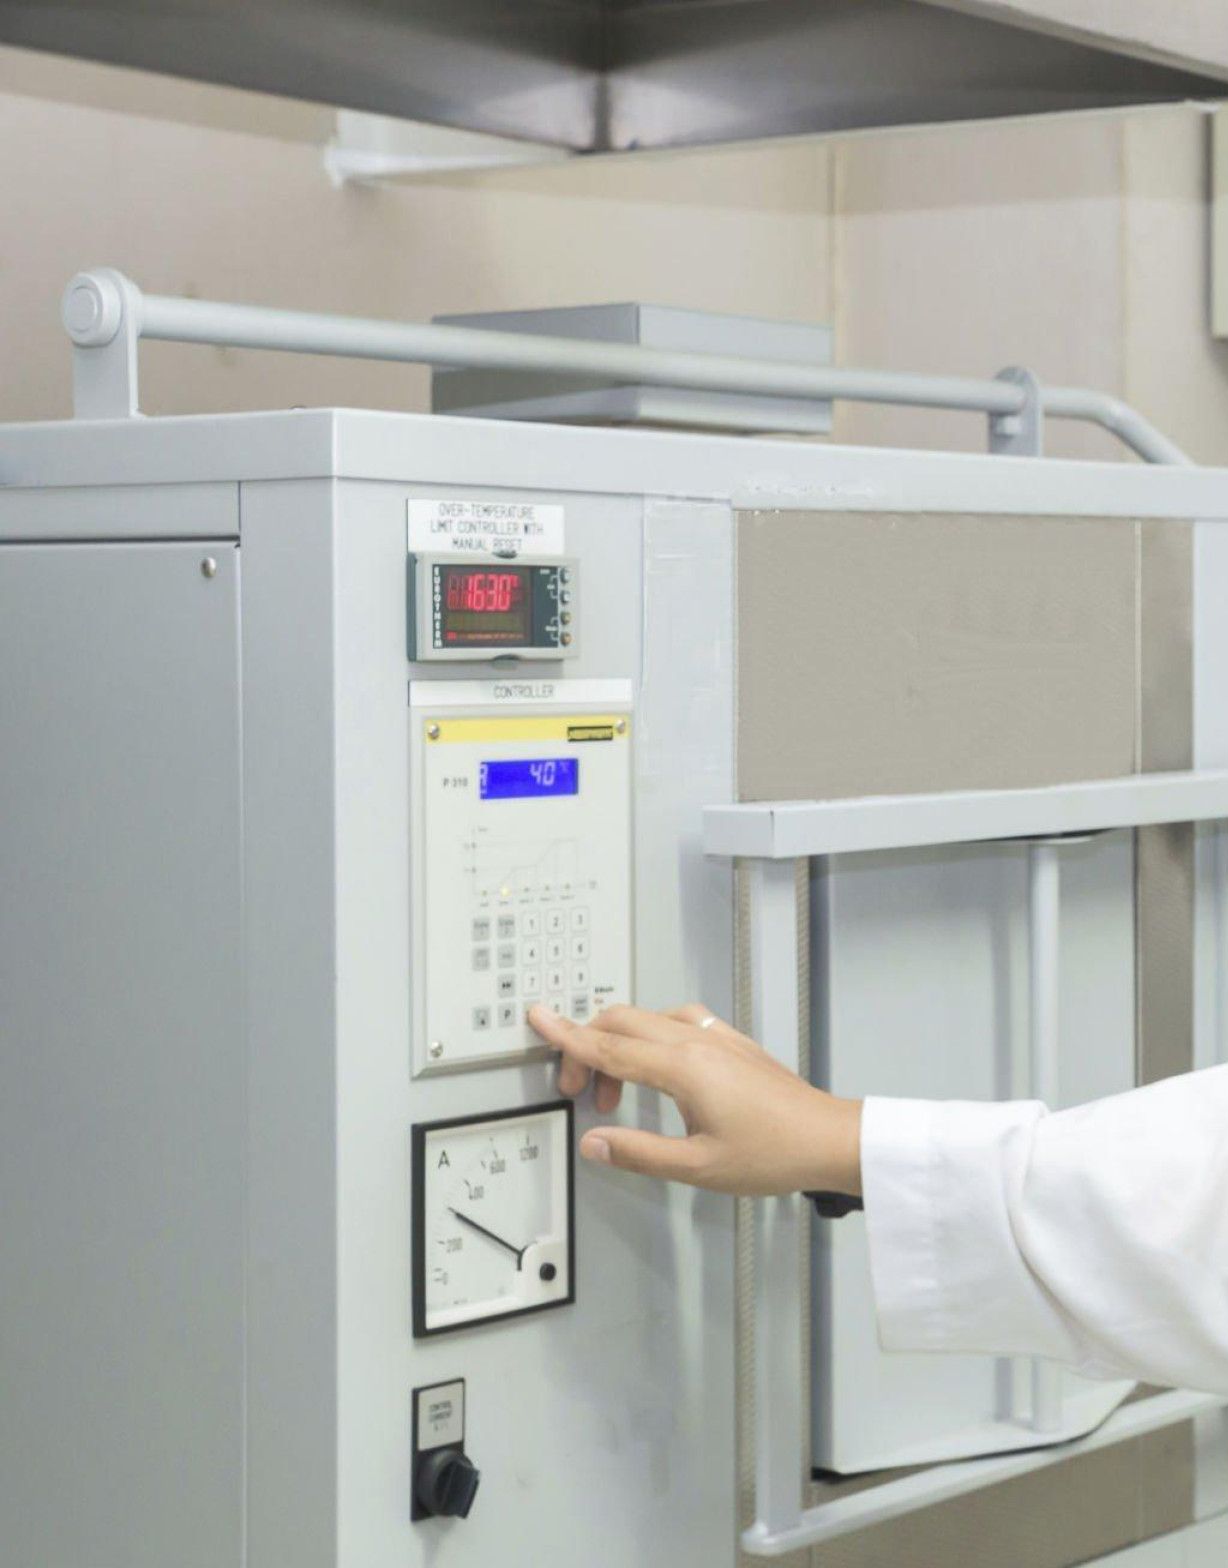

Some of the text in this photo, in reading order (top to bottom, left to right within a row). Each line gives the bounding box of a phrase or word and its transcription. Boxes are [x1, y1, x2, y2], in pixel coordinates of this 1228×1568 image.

[439, 503, 535, 520] OVER-TEMPERATURE
[431, 519, 544, 535] LIMIT CONTROLLER WITH
[452, 537, 522, 550] MANUAL RESET
[493, 684, 554, 699] CONTROLLER
[530, 761, 556, 786] 40
[438, 1149, 451, 1169] A
